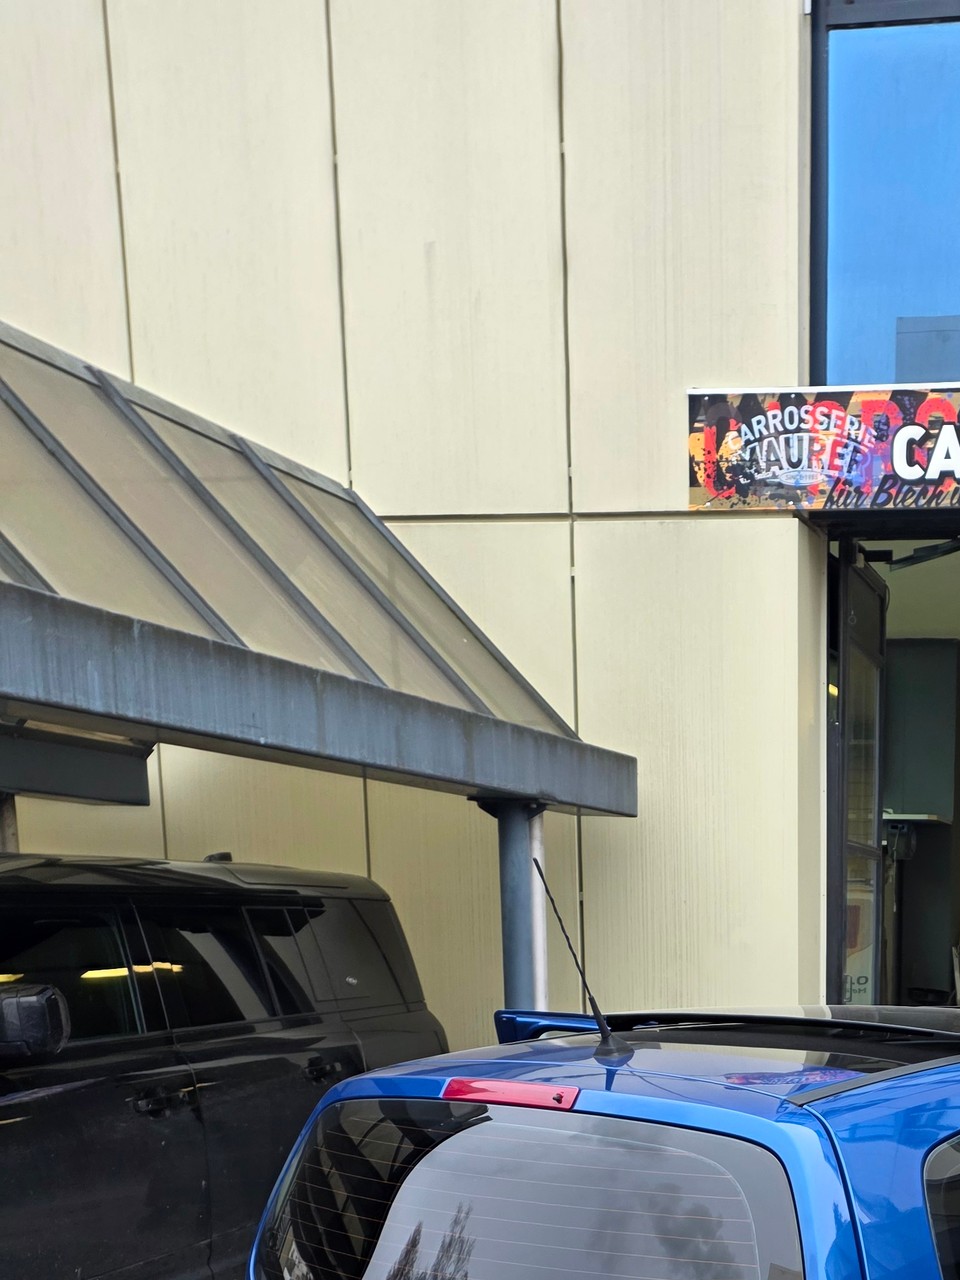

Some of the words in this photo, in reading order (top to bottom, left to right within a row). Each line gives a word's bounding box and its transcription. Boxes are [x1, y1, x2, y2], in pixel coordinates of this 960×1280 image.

[726, 404, 878, 451] CARROSSERIE
[823, 475, 870, 509] für
[869, 473, 945, 508] Blech
